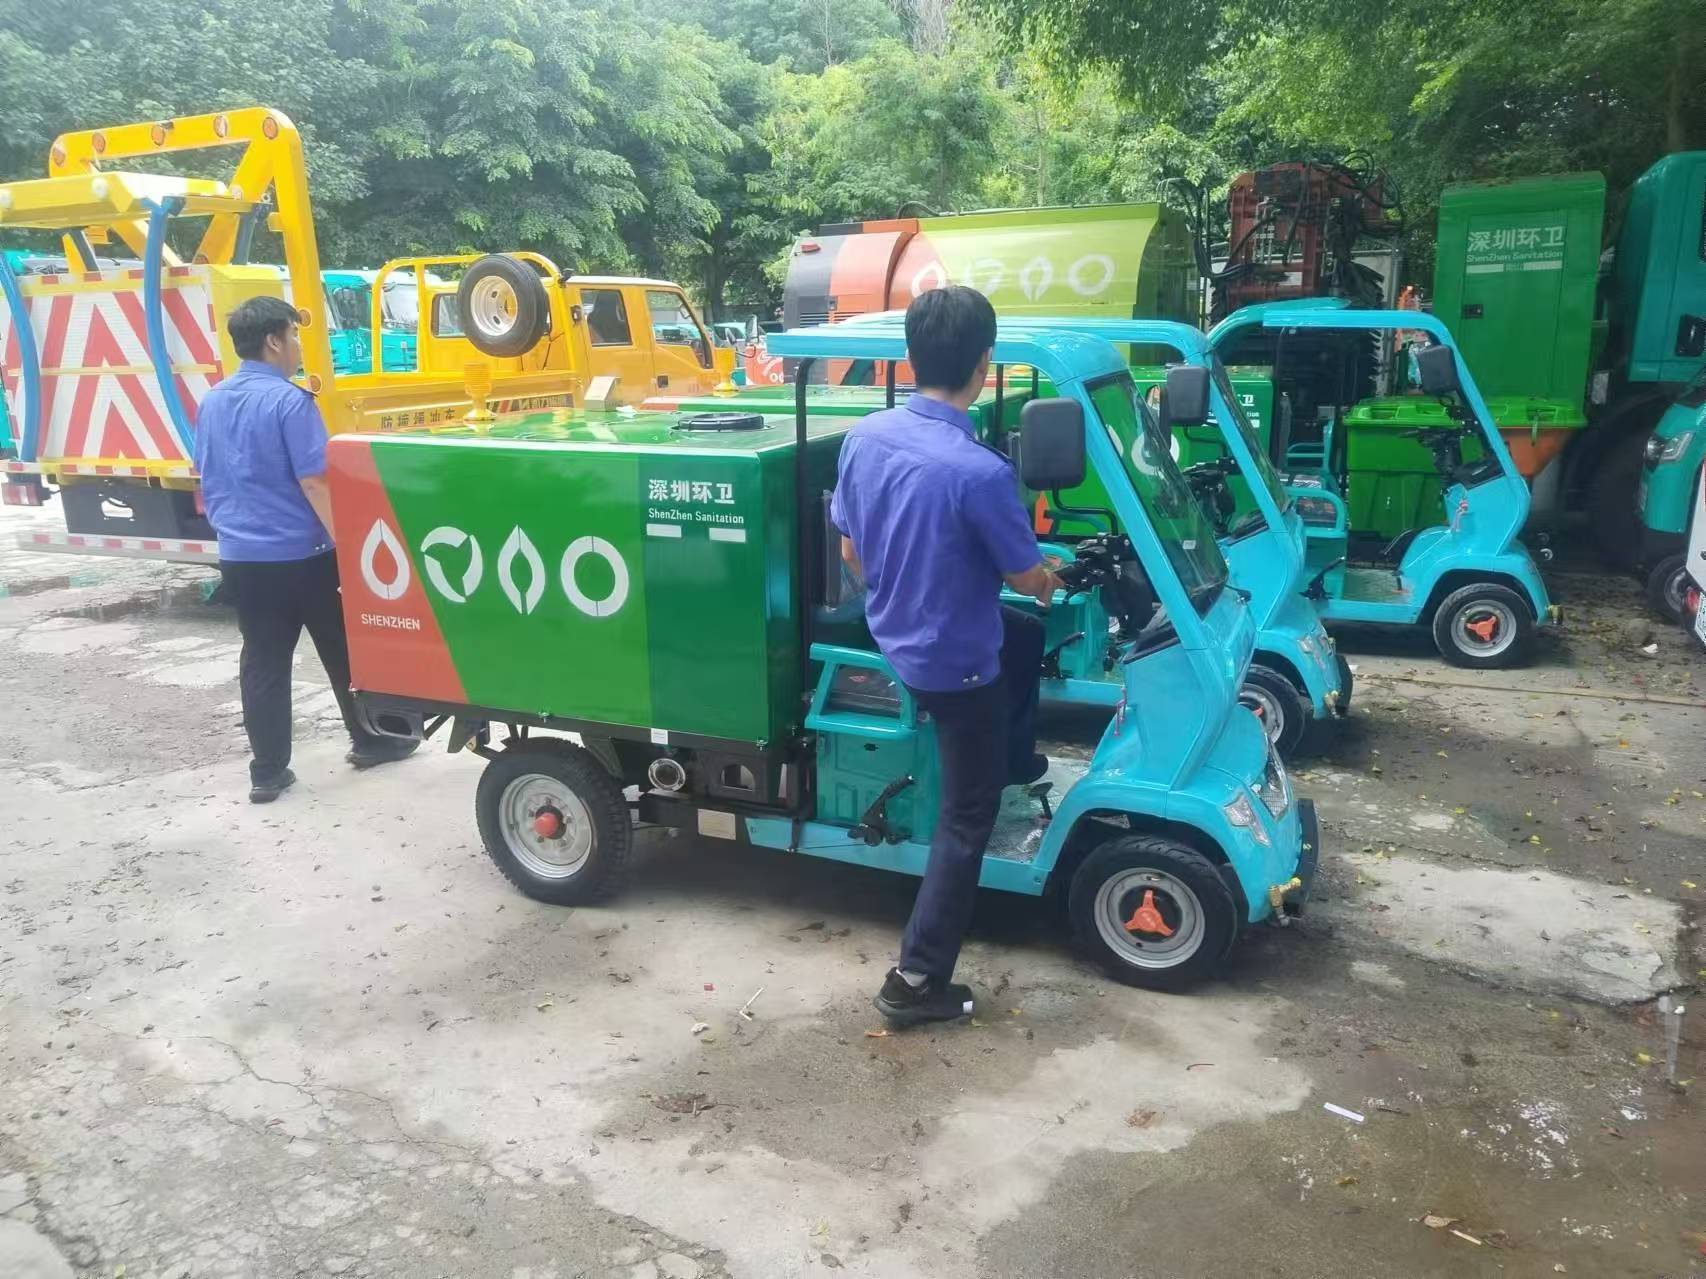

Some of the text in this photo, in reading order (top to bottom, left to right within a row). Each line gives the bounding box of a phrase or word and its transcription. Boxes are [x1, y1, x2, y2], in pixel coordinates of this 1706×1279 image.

[1467, 227, 1564, 252] 深圳环卫
[1512, 251, 1563, 260] Sanitation
[648, 479, 735, 504] 深圳环卫
[648, 507, 744, 524] ShenZhen Sanitation
[361, 613, 420, 631] SHENZHEN
